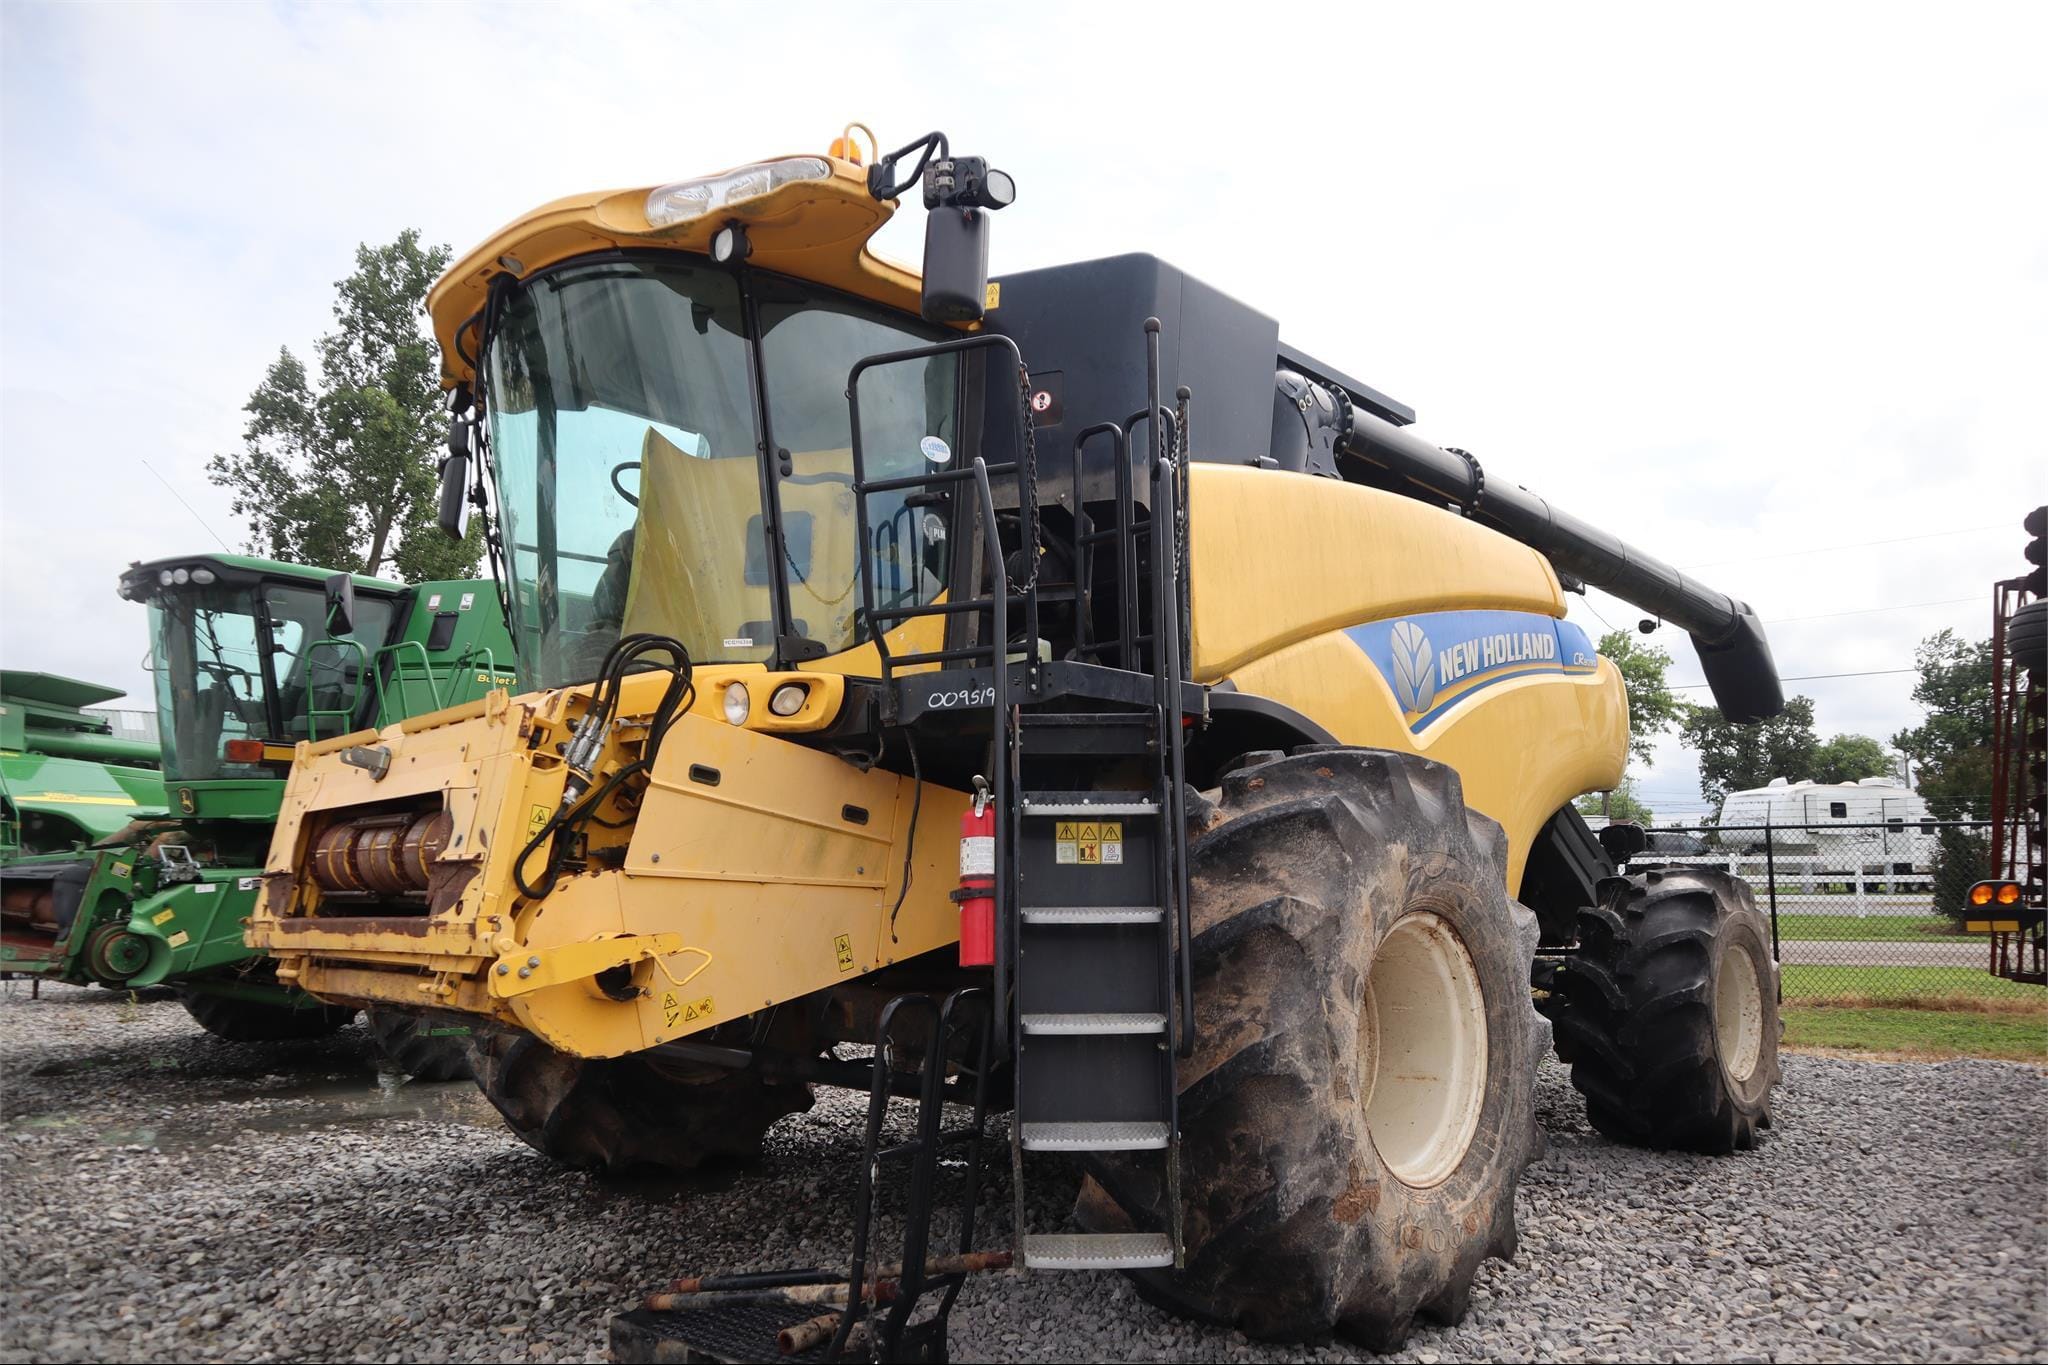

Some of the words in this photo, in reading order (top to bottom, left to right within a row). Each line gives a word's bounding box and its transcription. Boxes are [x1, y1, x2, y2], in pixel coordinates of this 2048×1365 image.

[933, 528, 946, 540] PLM
[1440, 639, 1479, 685] NEW
[1483, 633, 1554, 668] HOLLAND
[477, 674, 510, 685] Bulet
[928, 687, 995, 708] 009519
